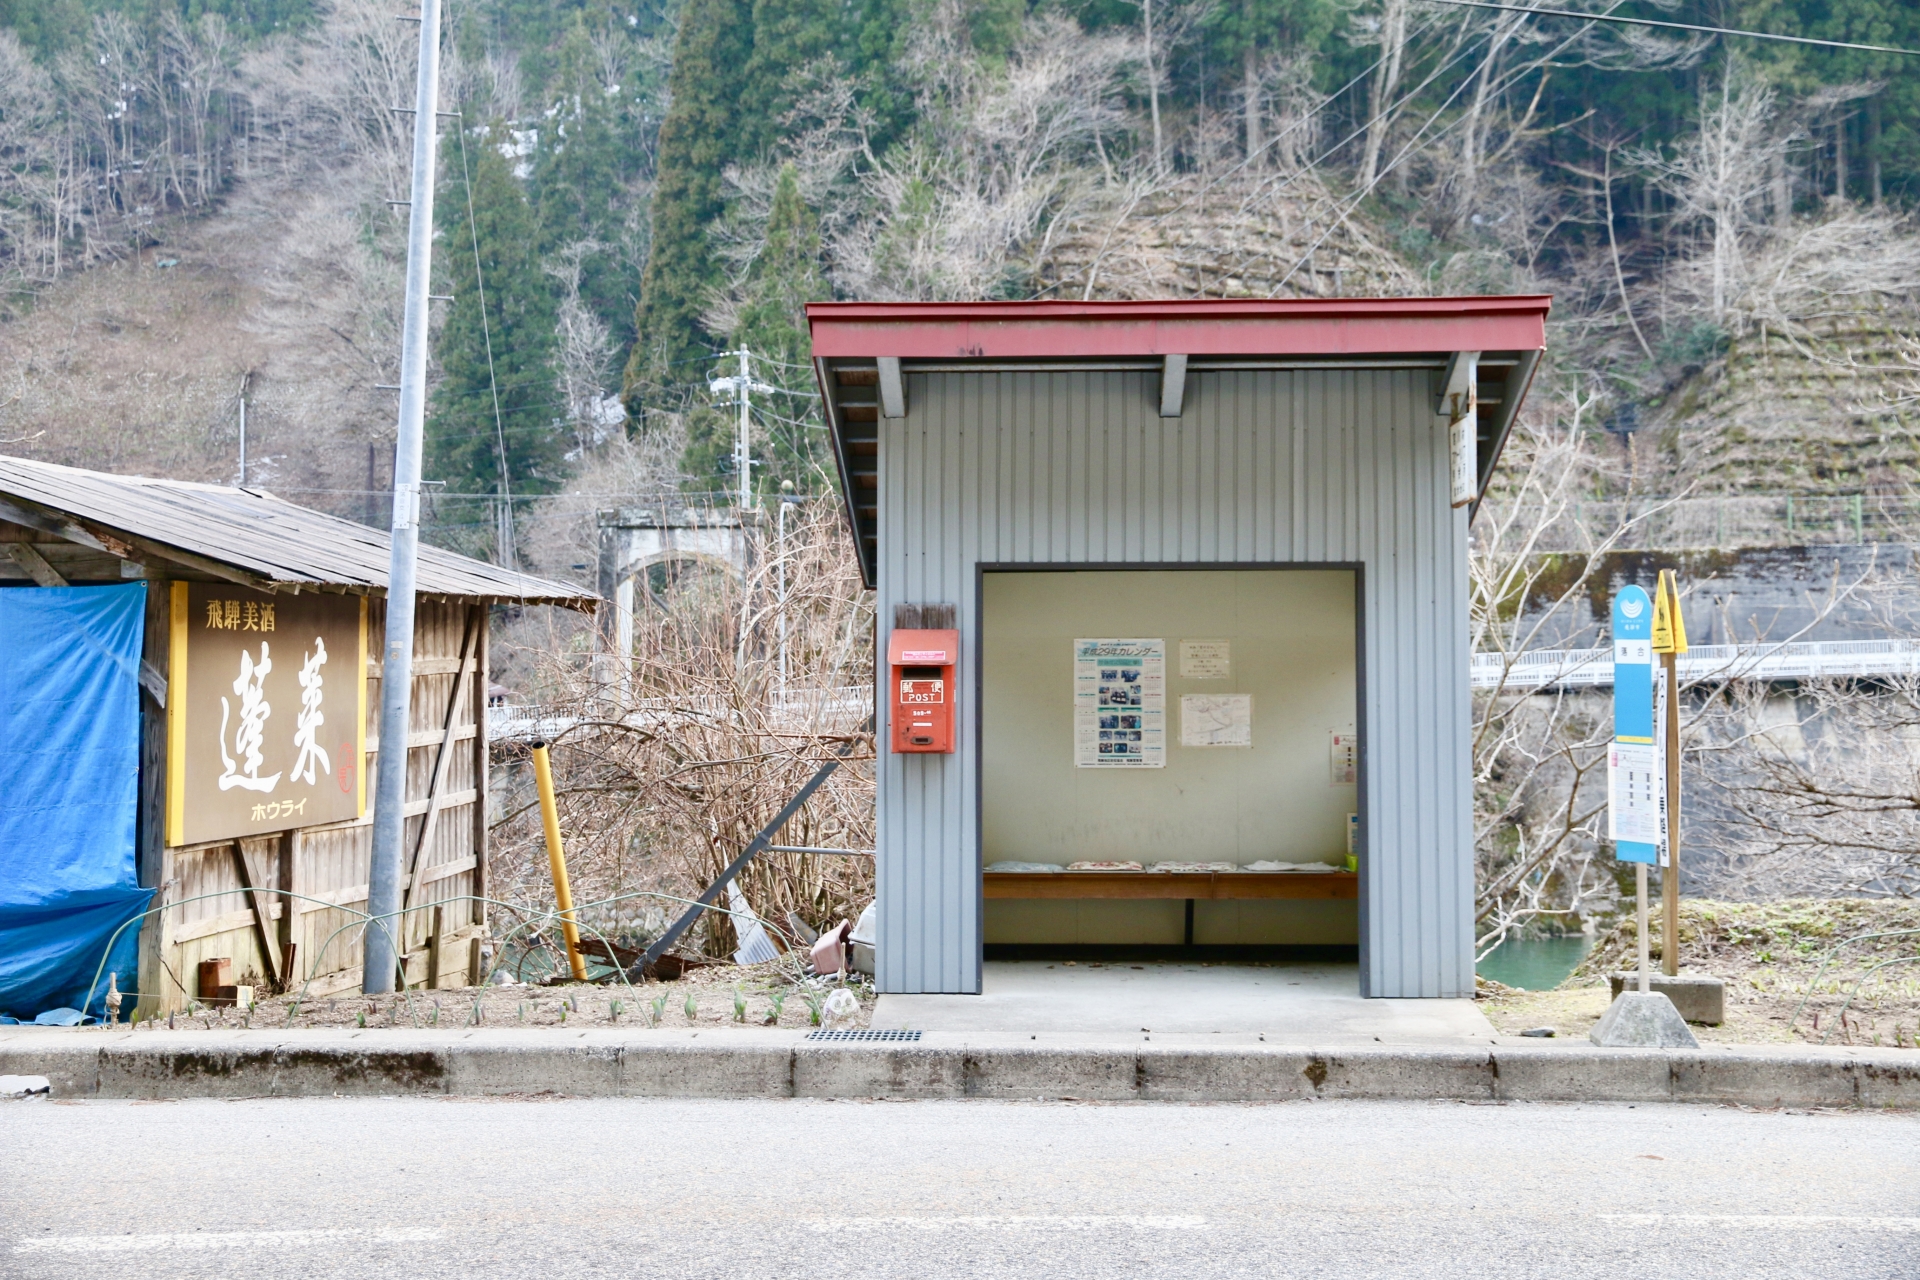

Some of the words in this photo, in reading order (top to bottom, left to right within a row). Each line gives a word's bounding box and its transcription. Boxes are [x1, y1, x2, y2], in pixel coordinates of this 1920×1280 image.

[206, 599, 275, 632] 飛騨美酒
[908, 694, 935, 702] POST
[251, 798, 307, 822] ホウライ
